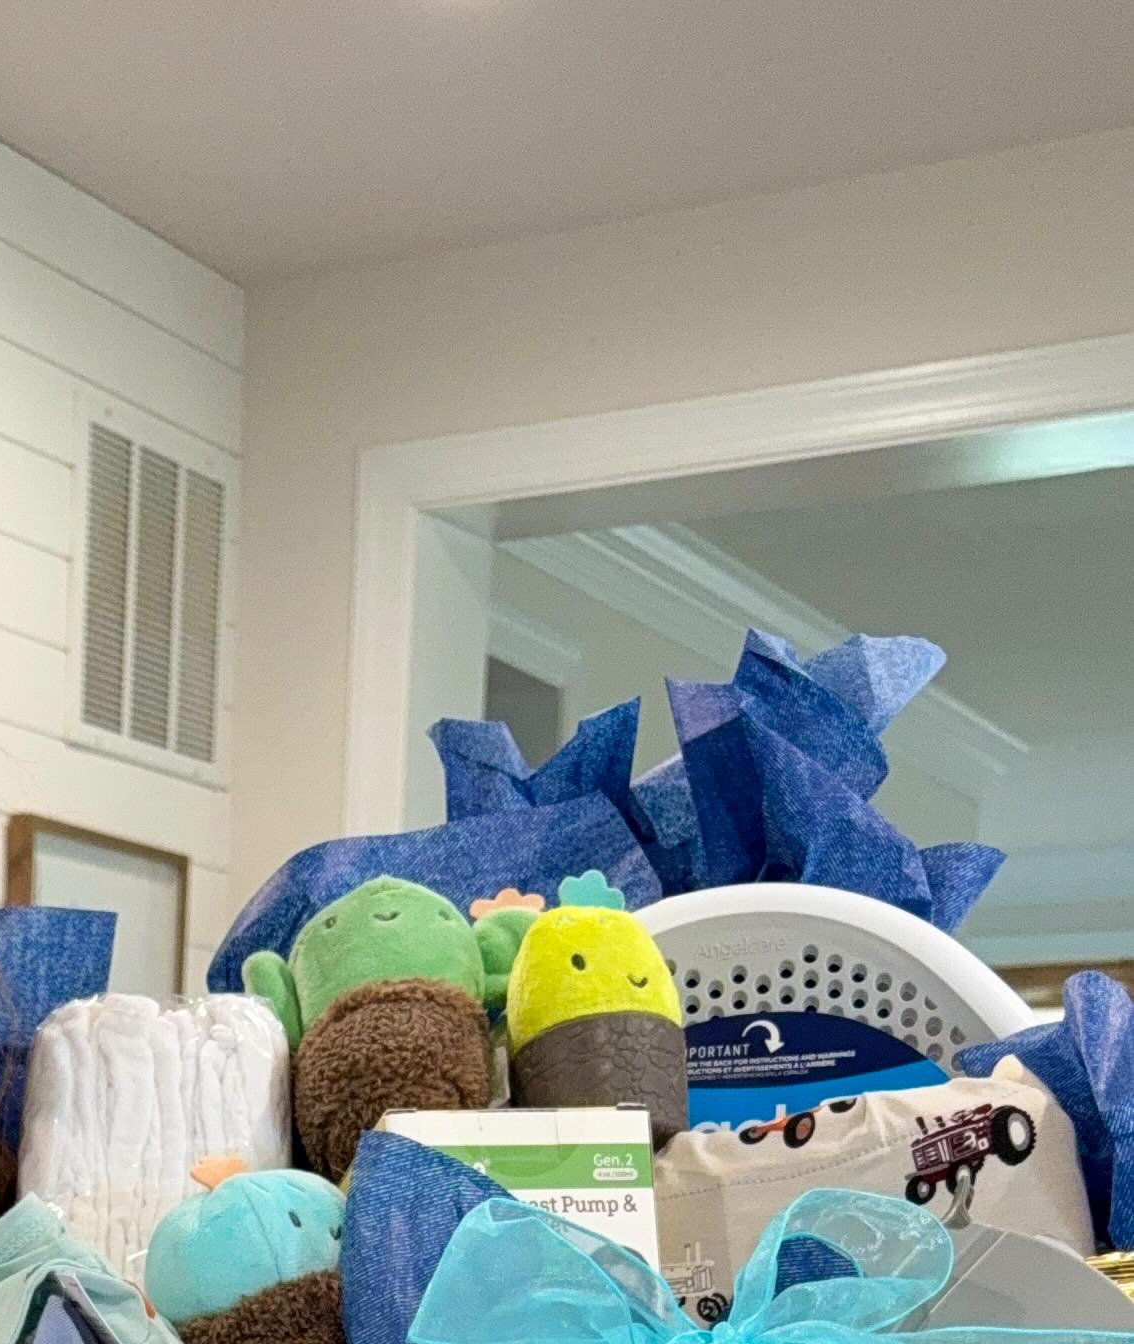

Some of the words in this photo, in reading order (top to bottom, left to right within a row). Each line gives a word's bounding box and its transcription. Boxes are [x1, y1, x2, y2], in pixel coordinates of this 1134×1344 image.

[685, 1044, 750, 1059] PORTANT
[562, 1195, 619, 1217] Pump
[623, 1194, 638, 1213] &
